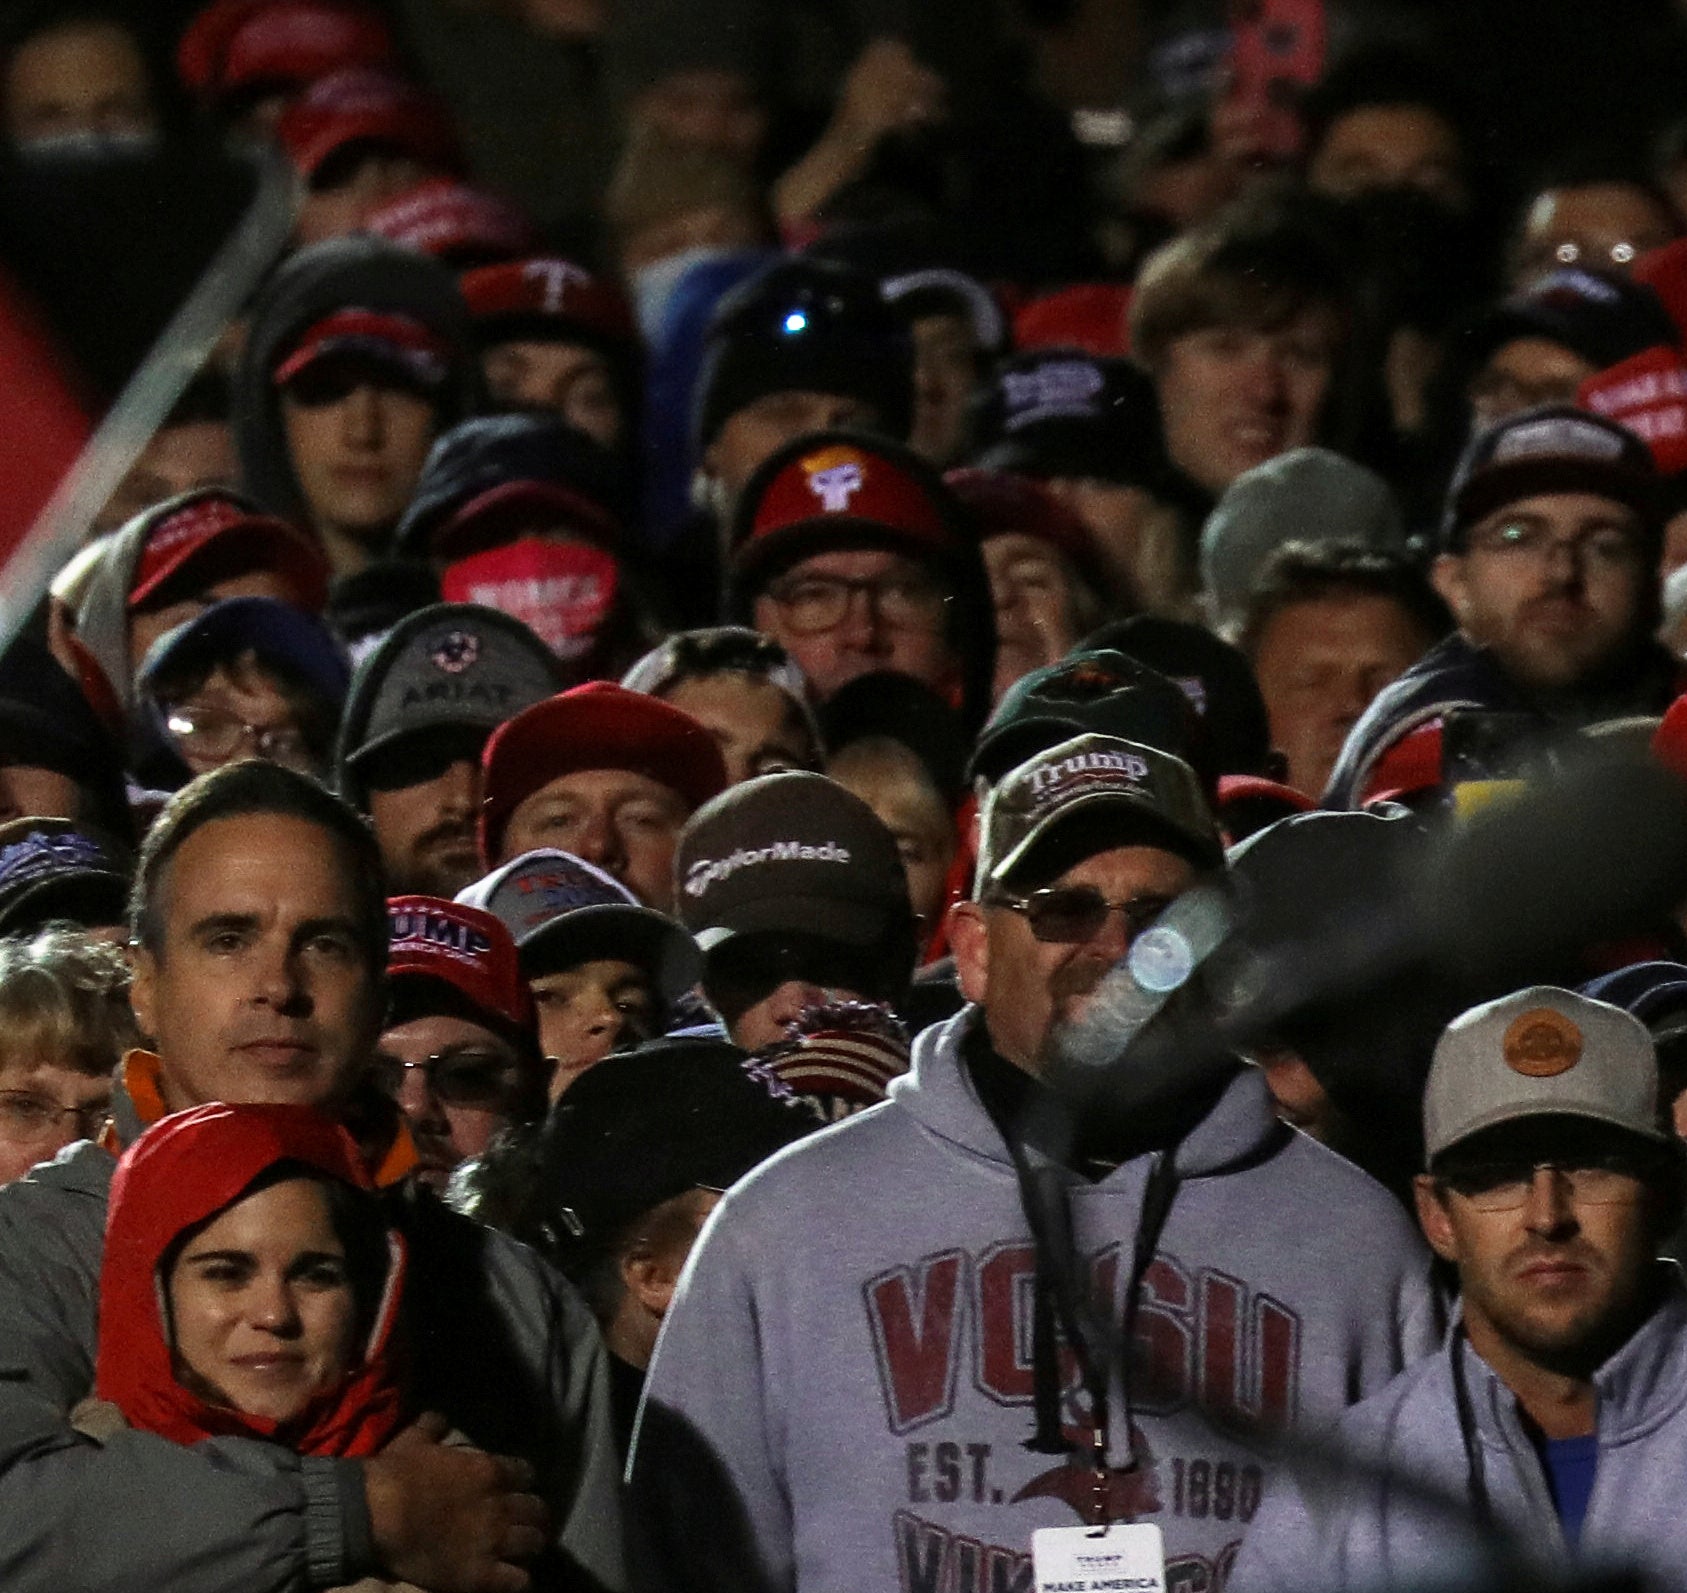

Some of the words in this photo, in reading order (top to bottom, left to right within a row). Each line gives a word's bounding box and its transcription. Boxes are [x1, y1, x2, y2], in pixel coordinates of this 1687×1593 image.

[1023, 751, 1149, 799] Trump
[684, 840, 850, 897] TaylorMade
[906, 1442, 1003, 1506] EST.
[1042, 1581, 1085, 1593] MAKE
[1091, 1577, 1158, 1592] AMERICA
